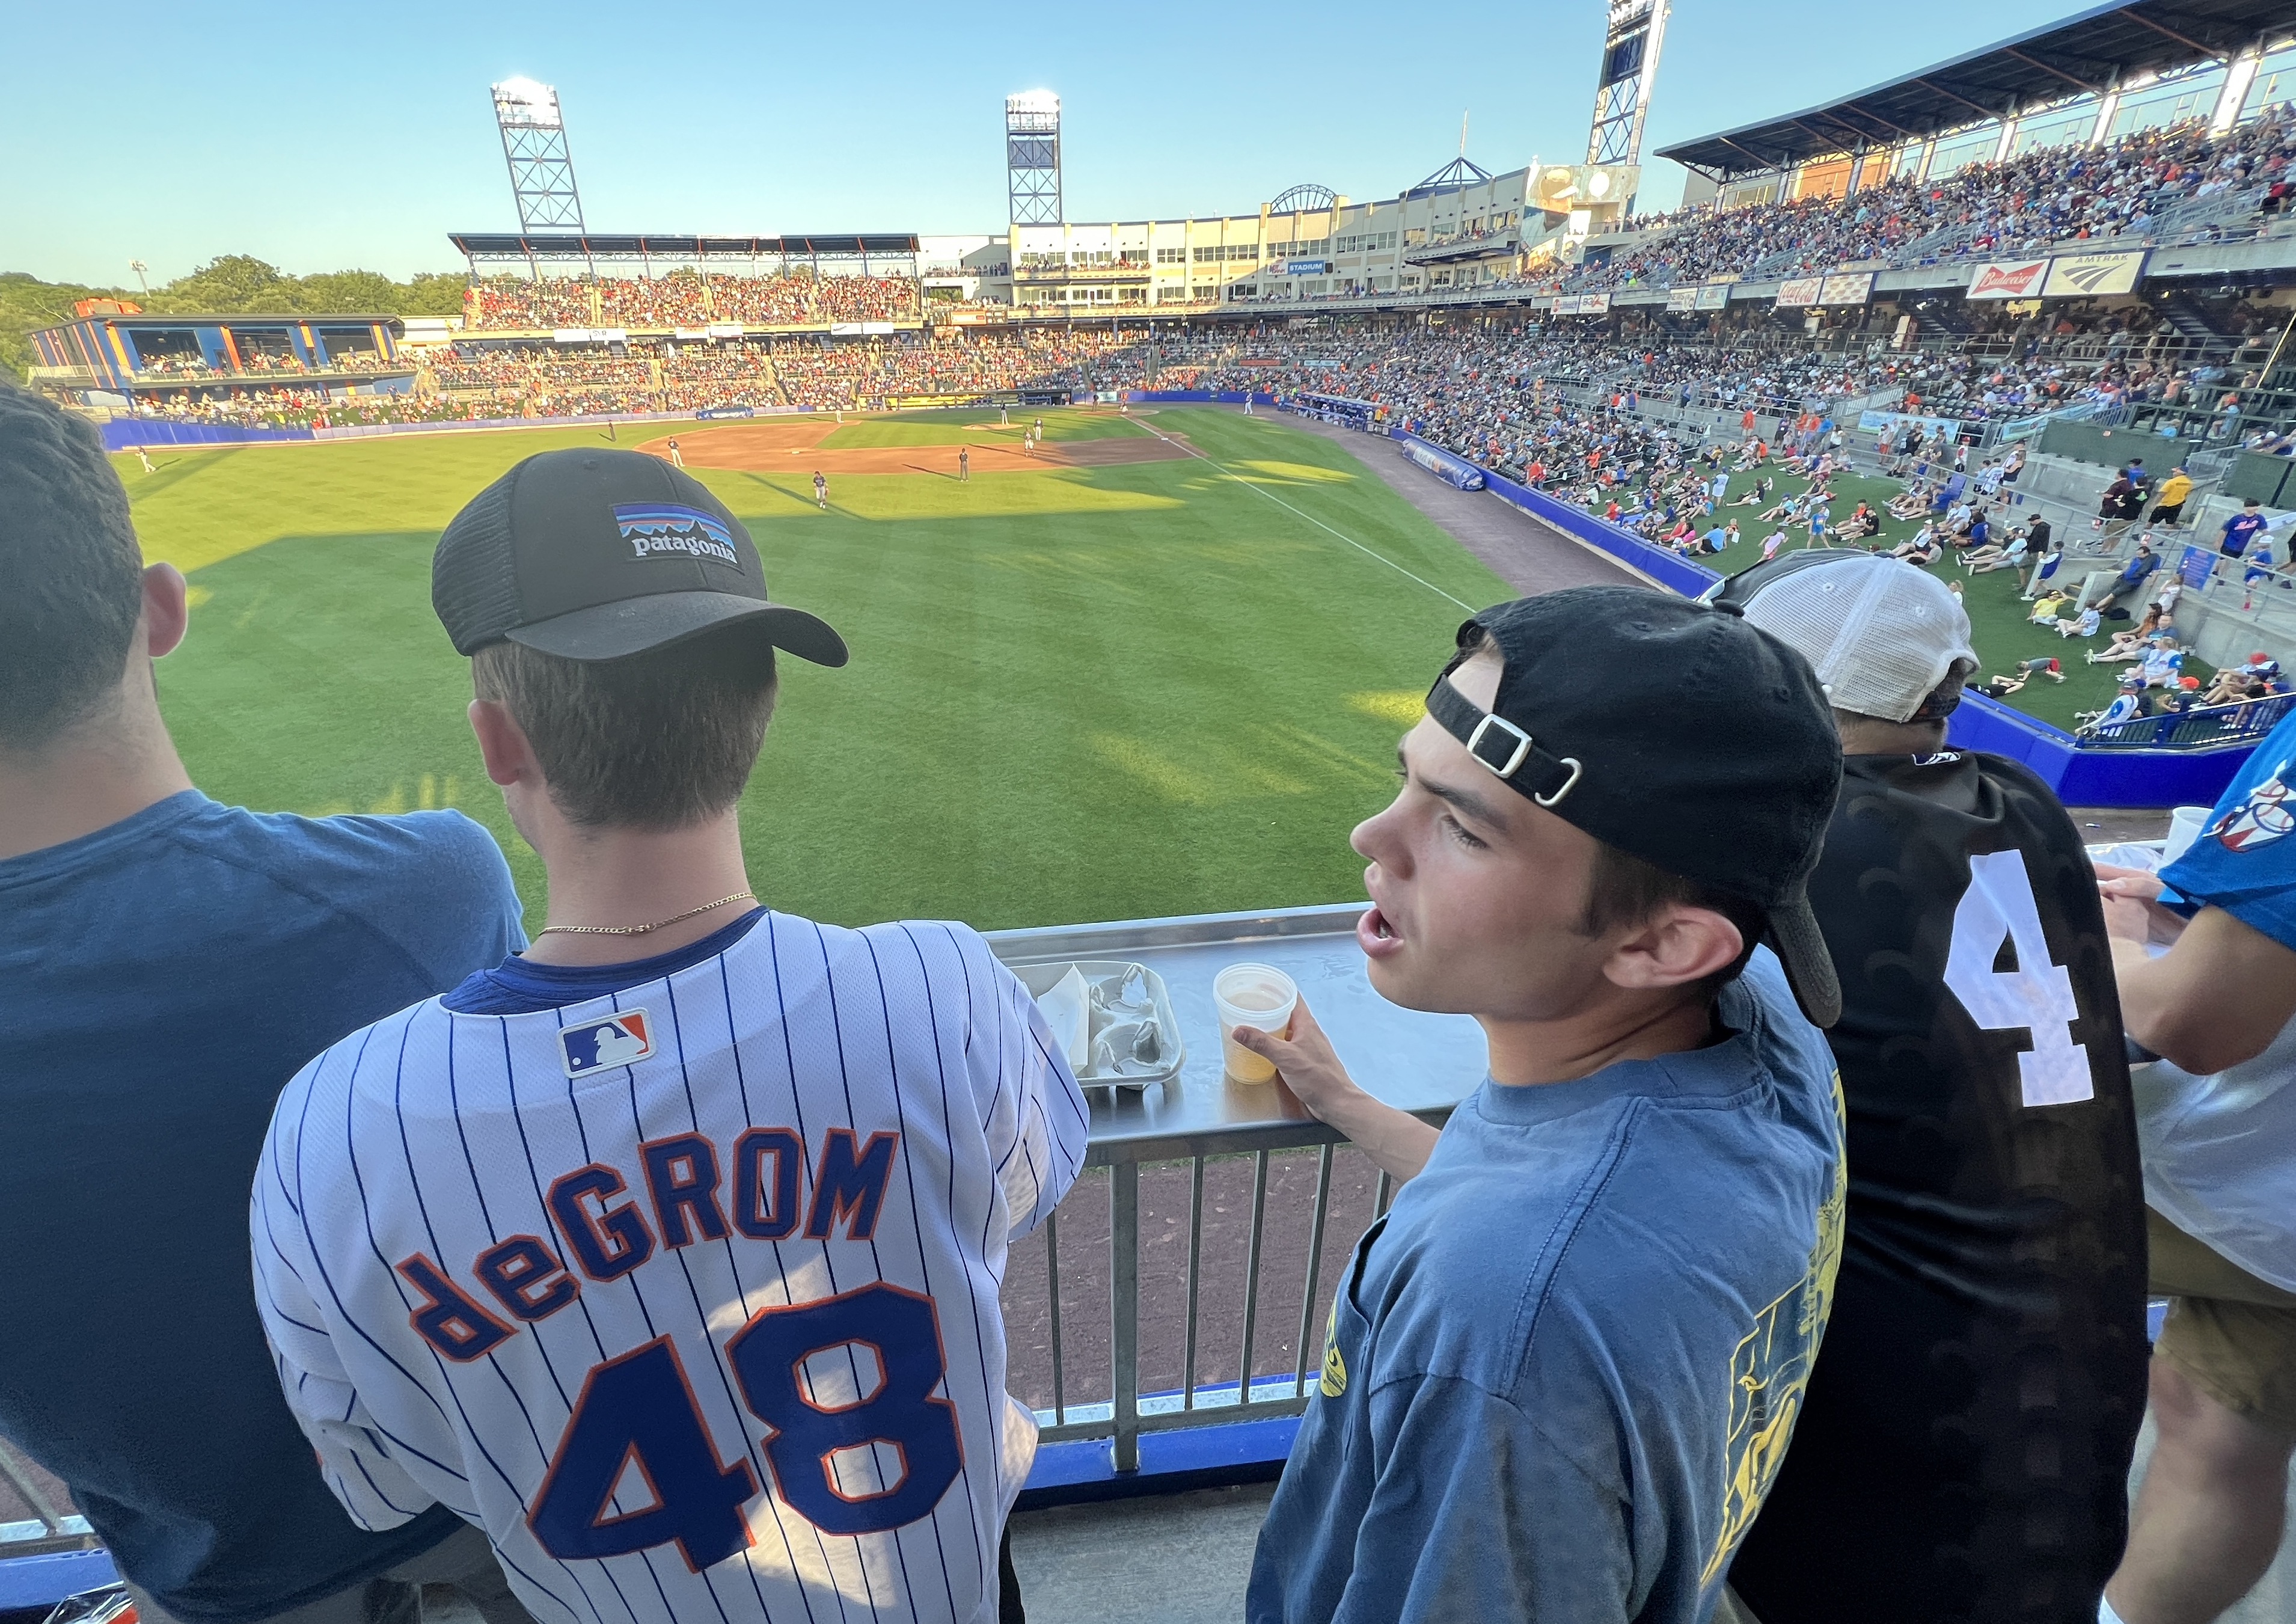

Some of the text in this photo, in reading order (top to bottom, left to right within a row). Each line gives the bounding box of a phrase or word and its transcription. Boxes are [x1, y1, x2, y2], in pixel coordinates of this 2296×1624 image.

[1289, 263, 1322, 271] STADIUM
[2075, 254, 2129, 264] AMTRAK
[1979, 272, 2034, 288] Budweiser
[631, 535, 738, 565] patagonia
[1942, 848, 2095, 1108] 4
[394, 1126, 901, 1362] deGROM
[525, 1279, 965, 1574] 48
